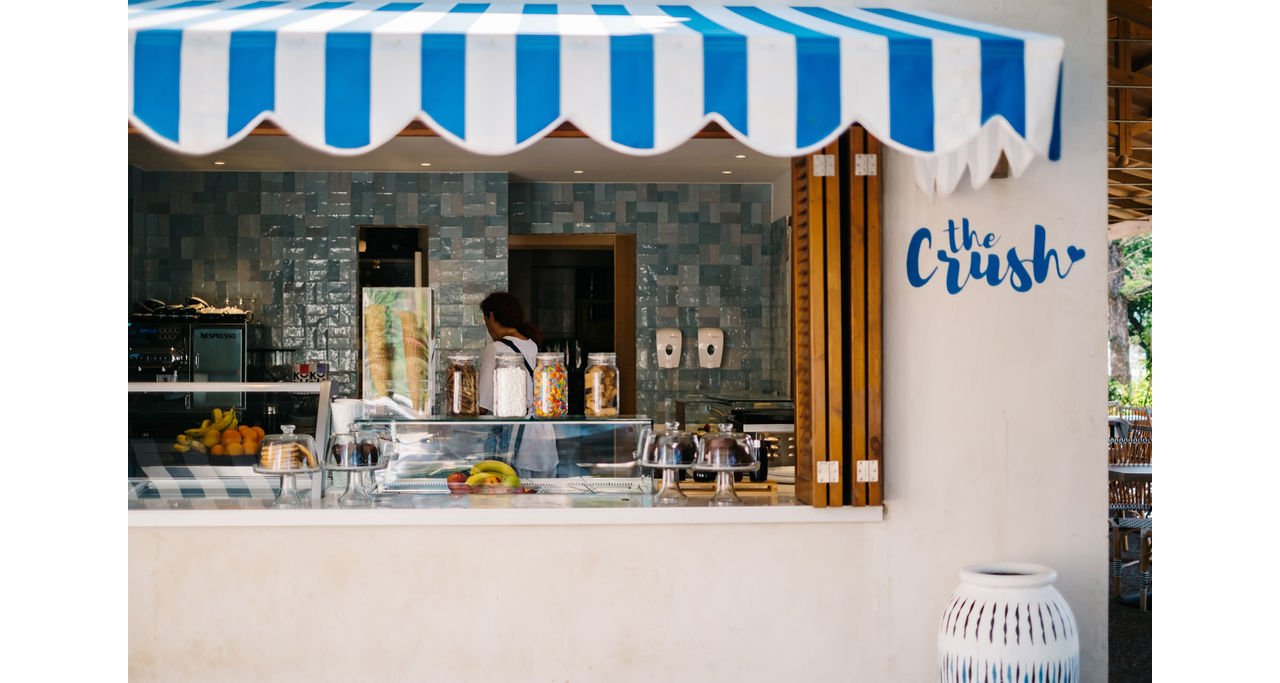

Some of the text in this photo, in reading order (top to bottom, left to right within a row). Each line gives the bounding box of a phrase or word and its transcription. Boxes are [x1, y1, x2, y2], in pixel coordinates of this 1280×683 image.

[942, 217, 1002, 254] the
[906, 224, 1075, 295] Crush
[200, 331, 237, 339] NESPRESSO
